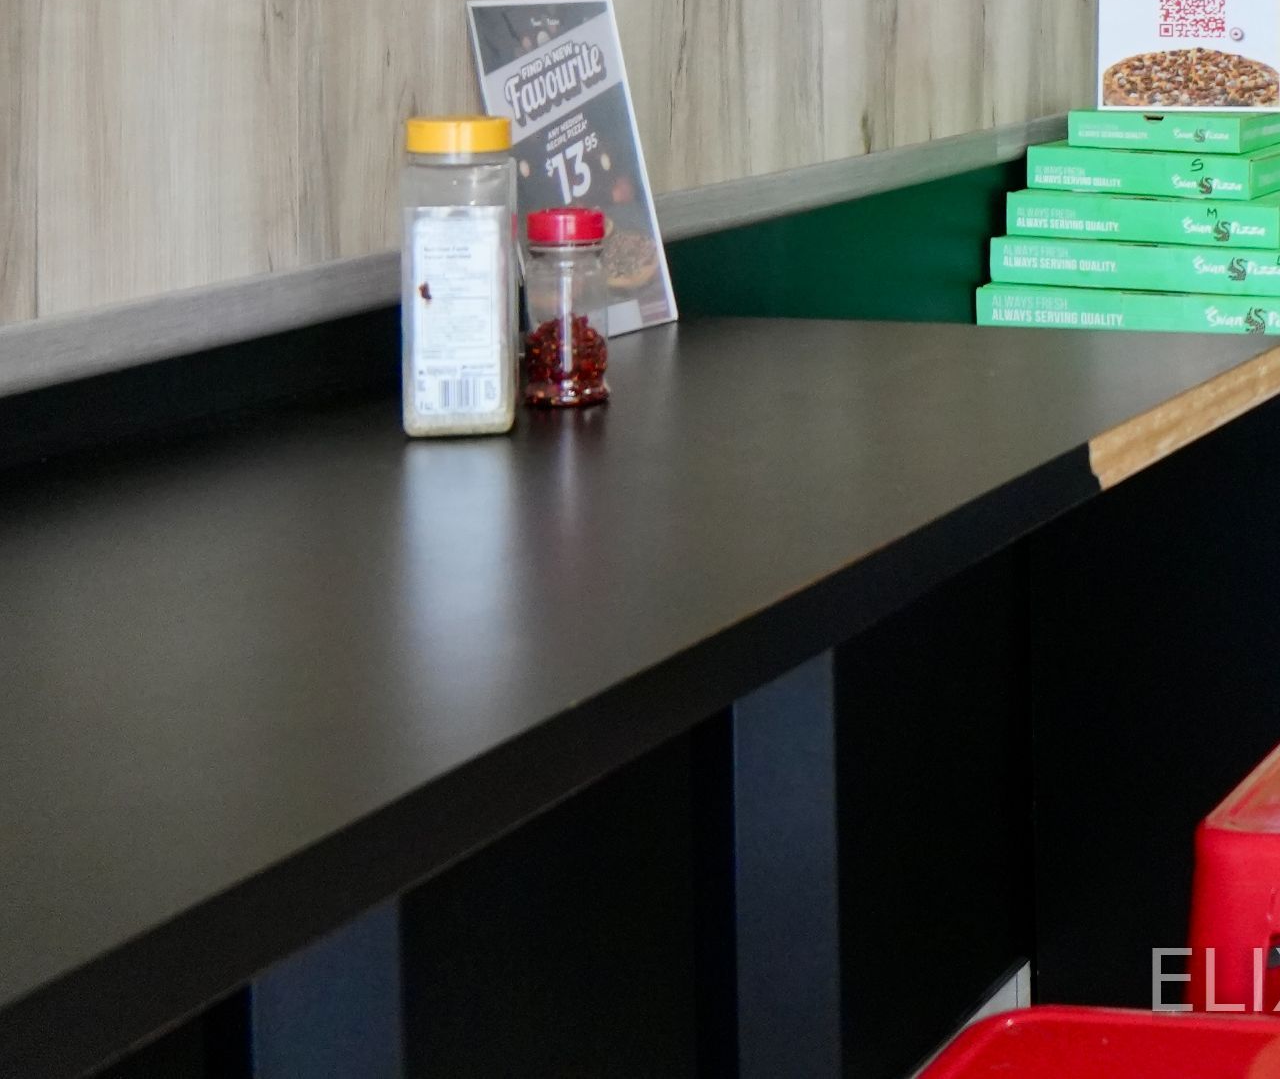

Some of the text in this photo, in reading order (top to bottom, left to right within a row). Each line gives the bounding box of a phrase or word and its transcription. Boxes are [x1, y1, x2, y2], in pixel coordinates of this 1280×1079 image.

[521, 57, 543, 80] FIND
[552, 41, 573, 63] NEW
[504, 42, 603, 122] Favourite
[1206, 208, 1218, 218] M
[1016, 217, 1048, 228] ALWAYS
[1049, 219, 1084, 231] SERVING
[1003, 256, 1038, 268] ALWAYS
[1040, 258, 1077, 270] SERVING
[992, 295, 1068, 310] ALWAYS FRESH
[991, 308, 1032, 322] ALWAYS
[1035, 310, 1078, 324] SERVING
[1205, 305, 1246, 327] Swan
